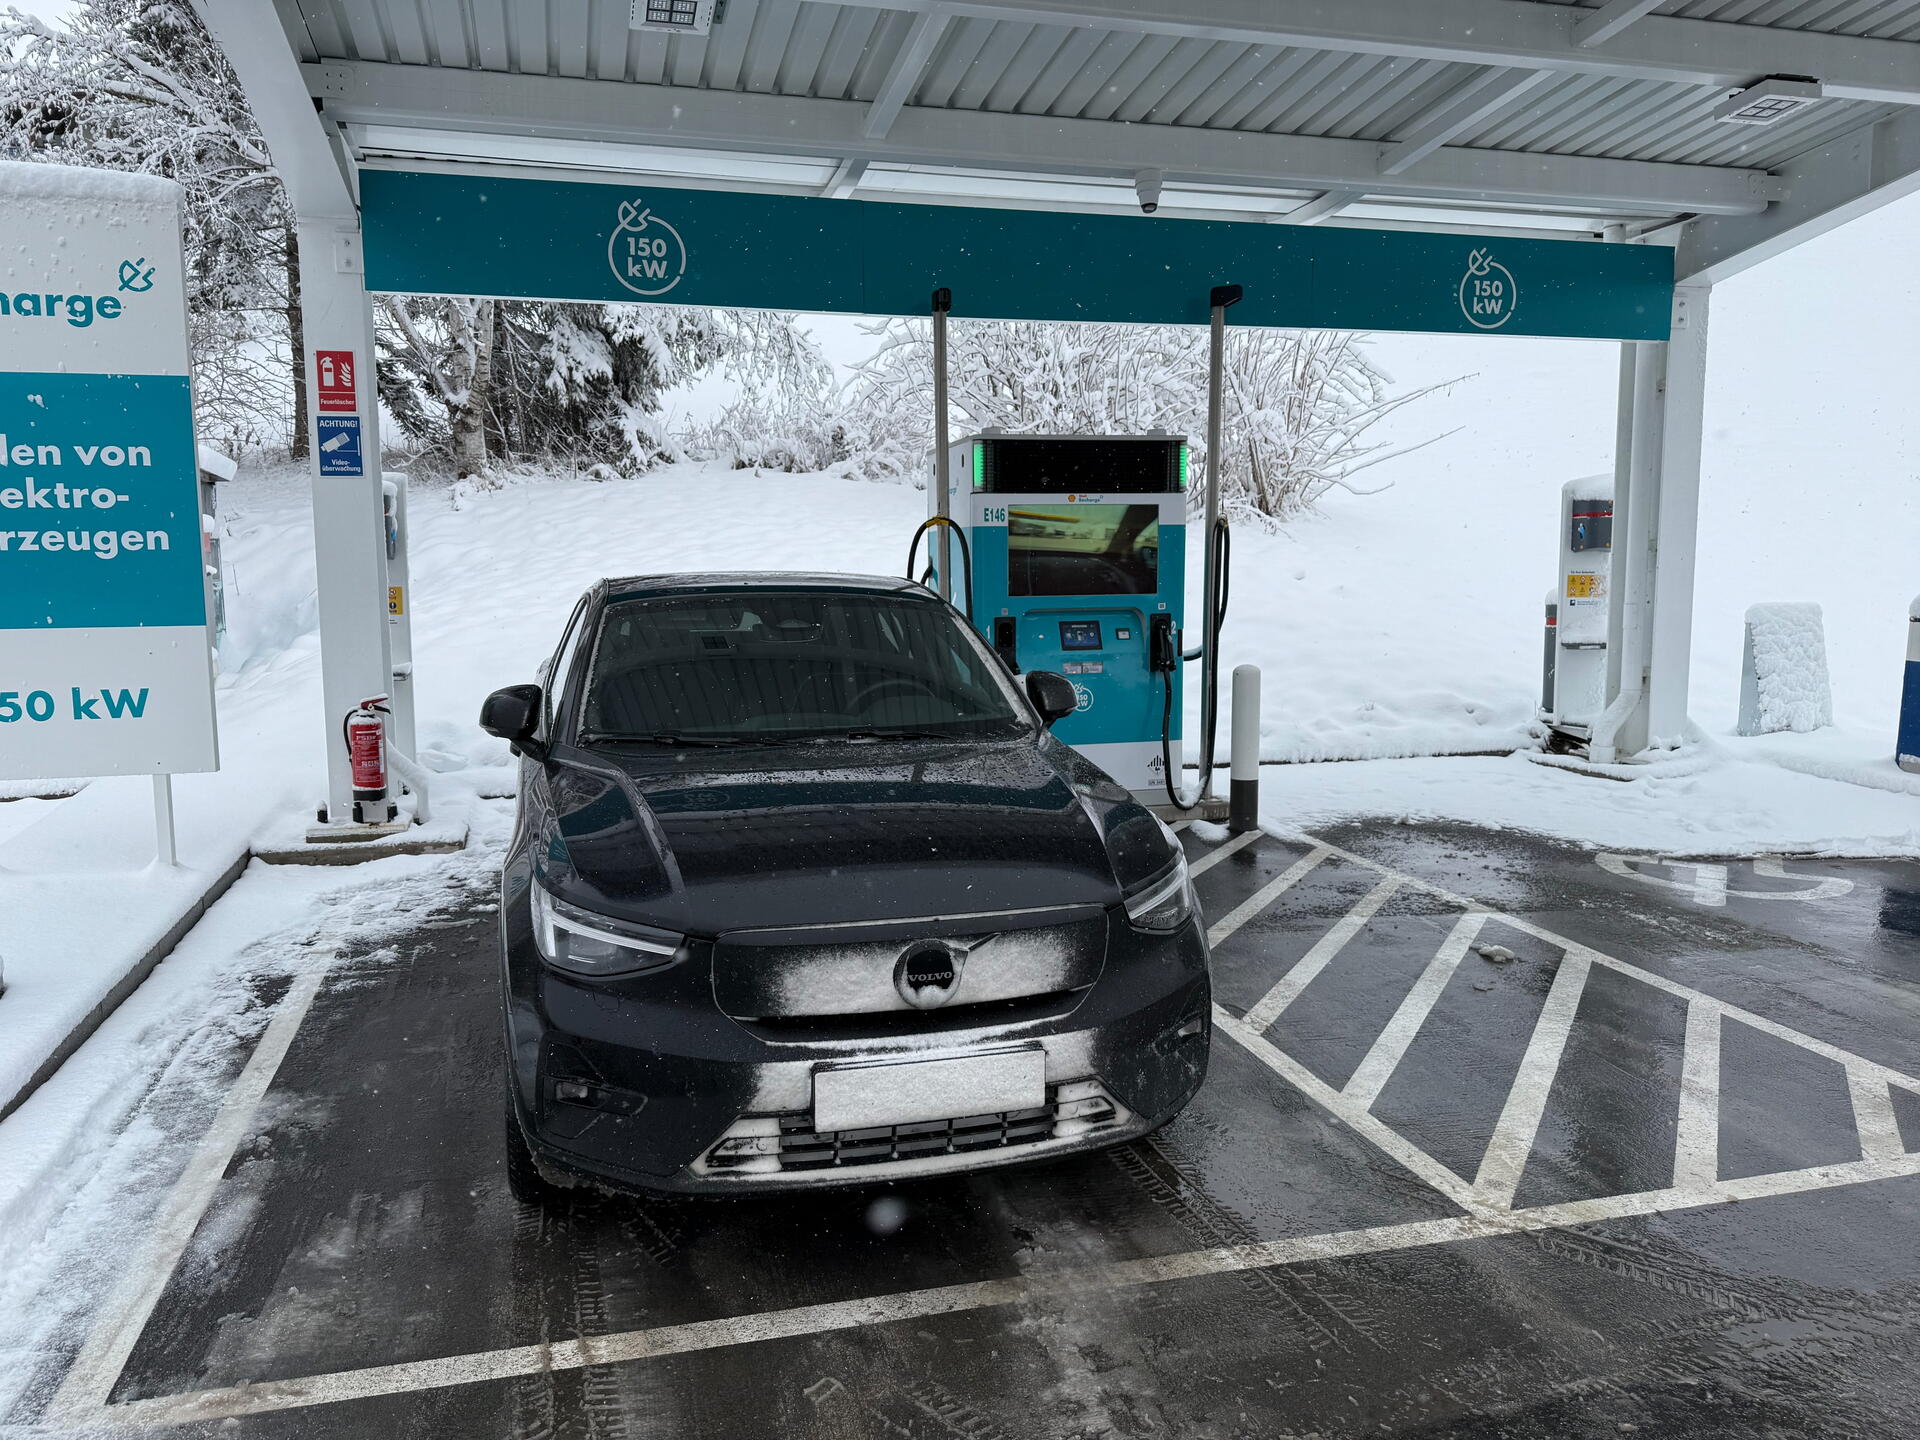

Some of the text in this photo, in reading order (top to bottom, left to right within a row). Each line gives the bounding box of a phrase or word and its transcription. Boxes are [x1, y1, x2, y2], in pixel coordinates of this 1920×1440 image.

[627, 237, 667, 257] 150
[627, 257, 668, 278] kW
[1474, 280, 1503, 297] 150
[1473, 297, 1503, 315] kW
[320, 398, 355, 406] Feuerlöscher
[319, 420, 358, 428] ACHTUNG!
[73, 445, 152, 467] von
[321, 465, 361, 473] überwachung
[0, 476, 130, 510] ektro-
[983, 507, 1006, 522] E146
[0, 530, 170, 560] rzeugen
[1170, 620, 1177, 635] 2
[0, 687, 150, 724] 50 kW
[907, 971, 952, 982] VOLVO
